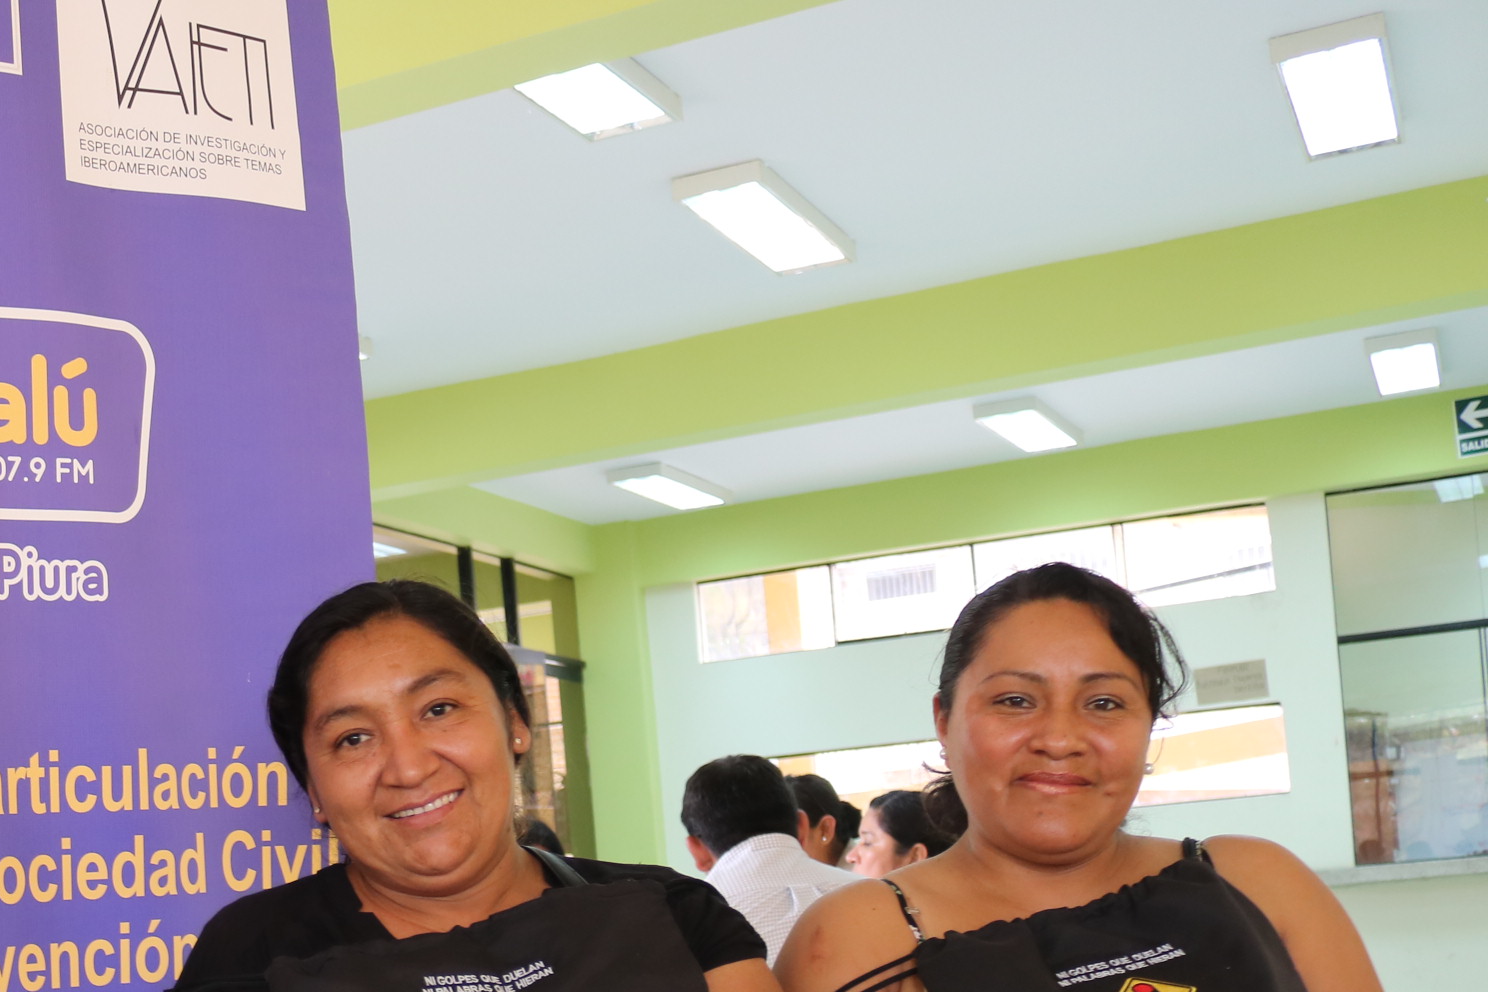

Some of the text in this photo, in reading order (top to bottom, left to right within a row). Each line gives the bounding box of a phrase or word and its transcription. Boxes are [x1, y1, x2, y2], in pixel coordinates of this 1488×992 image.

[79, 122, 286, 160] ASOCIACIÓN DE INVESTIGACIÓN Y
[80, 139, 282, 175] ESPECIALIZACIÓN SOBRE TEMAS
[81, 156, 207, 180] IBEROAMERICANOS
[56, 458, 94, 484] FM
[424, 960, 545, 986] NI GOLPES QUE DUELAN
[516, 967, 554, 990] HIERAN
